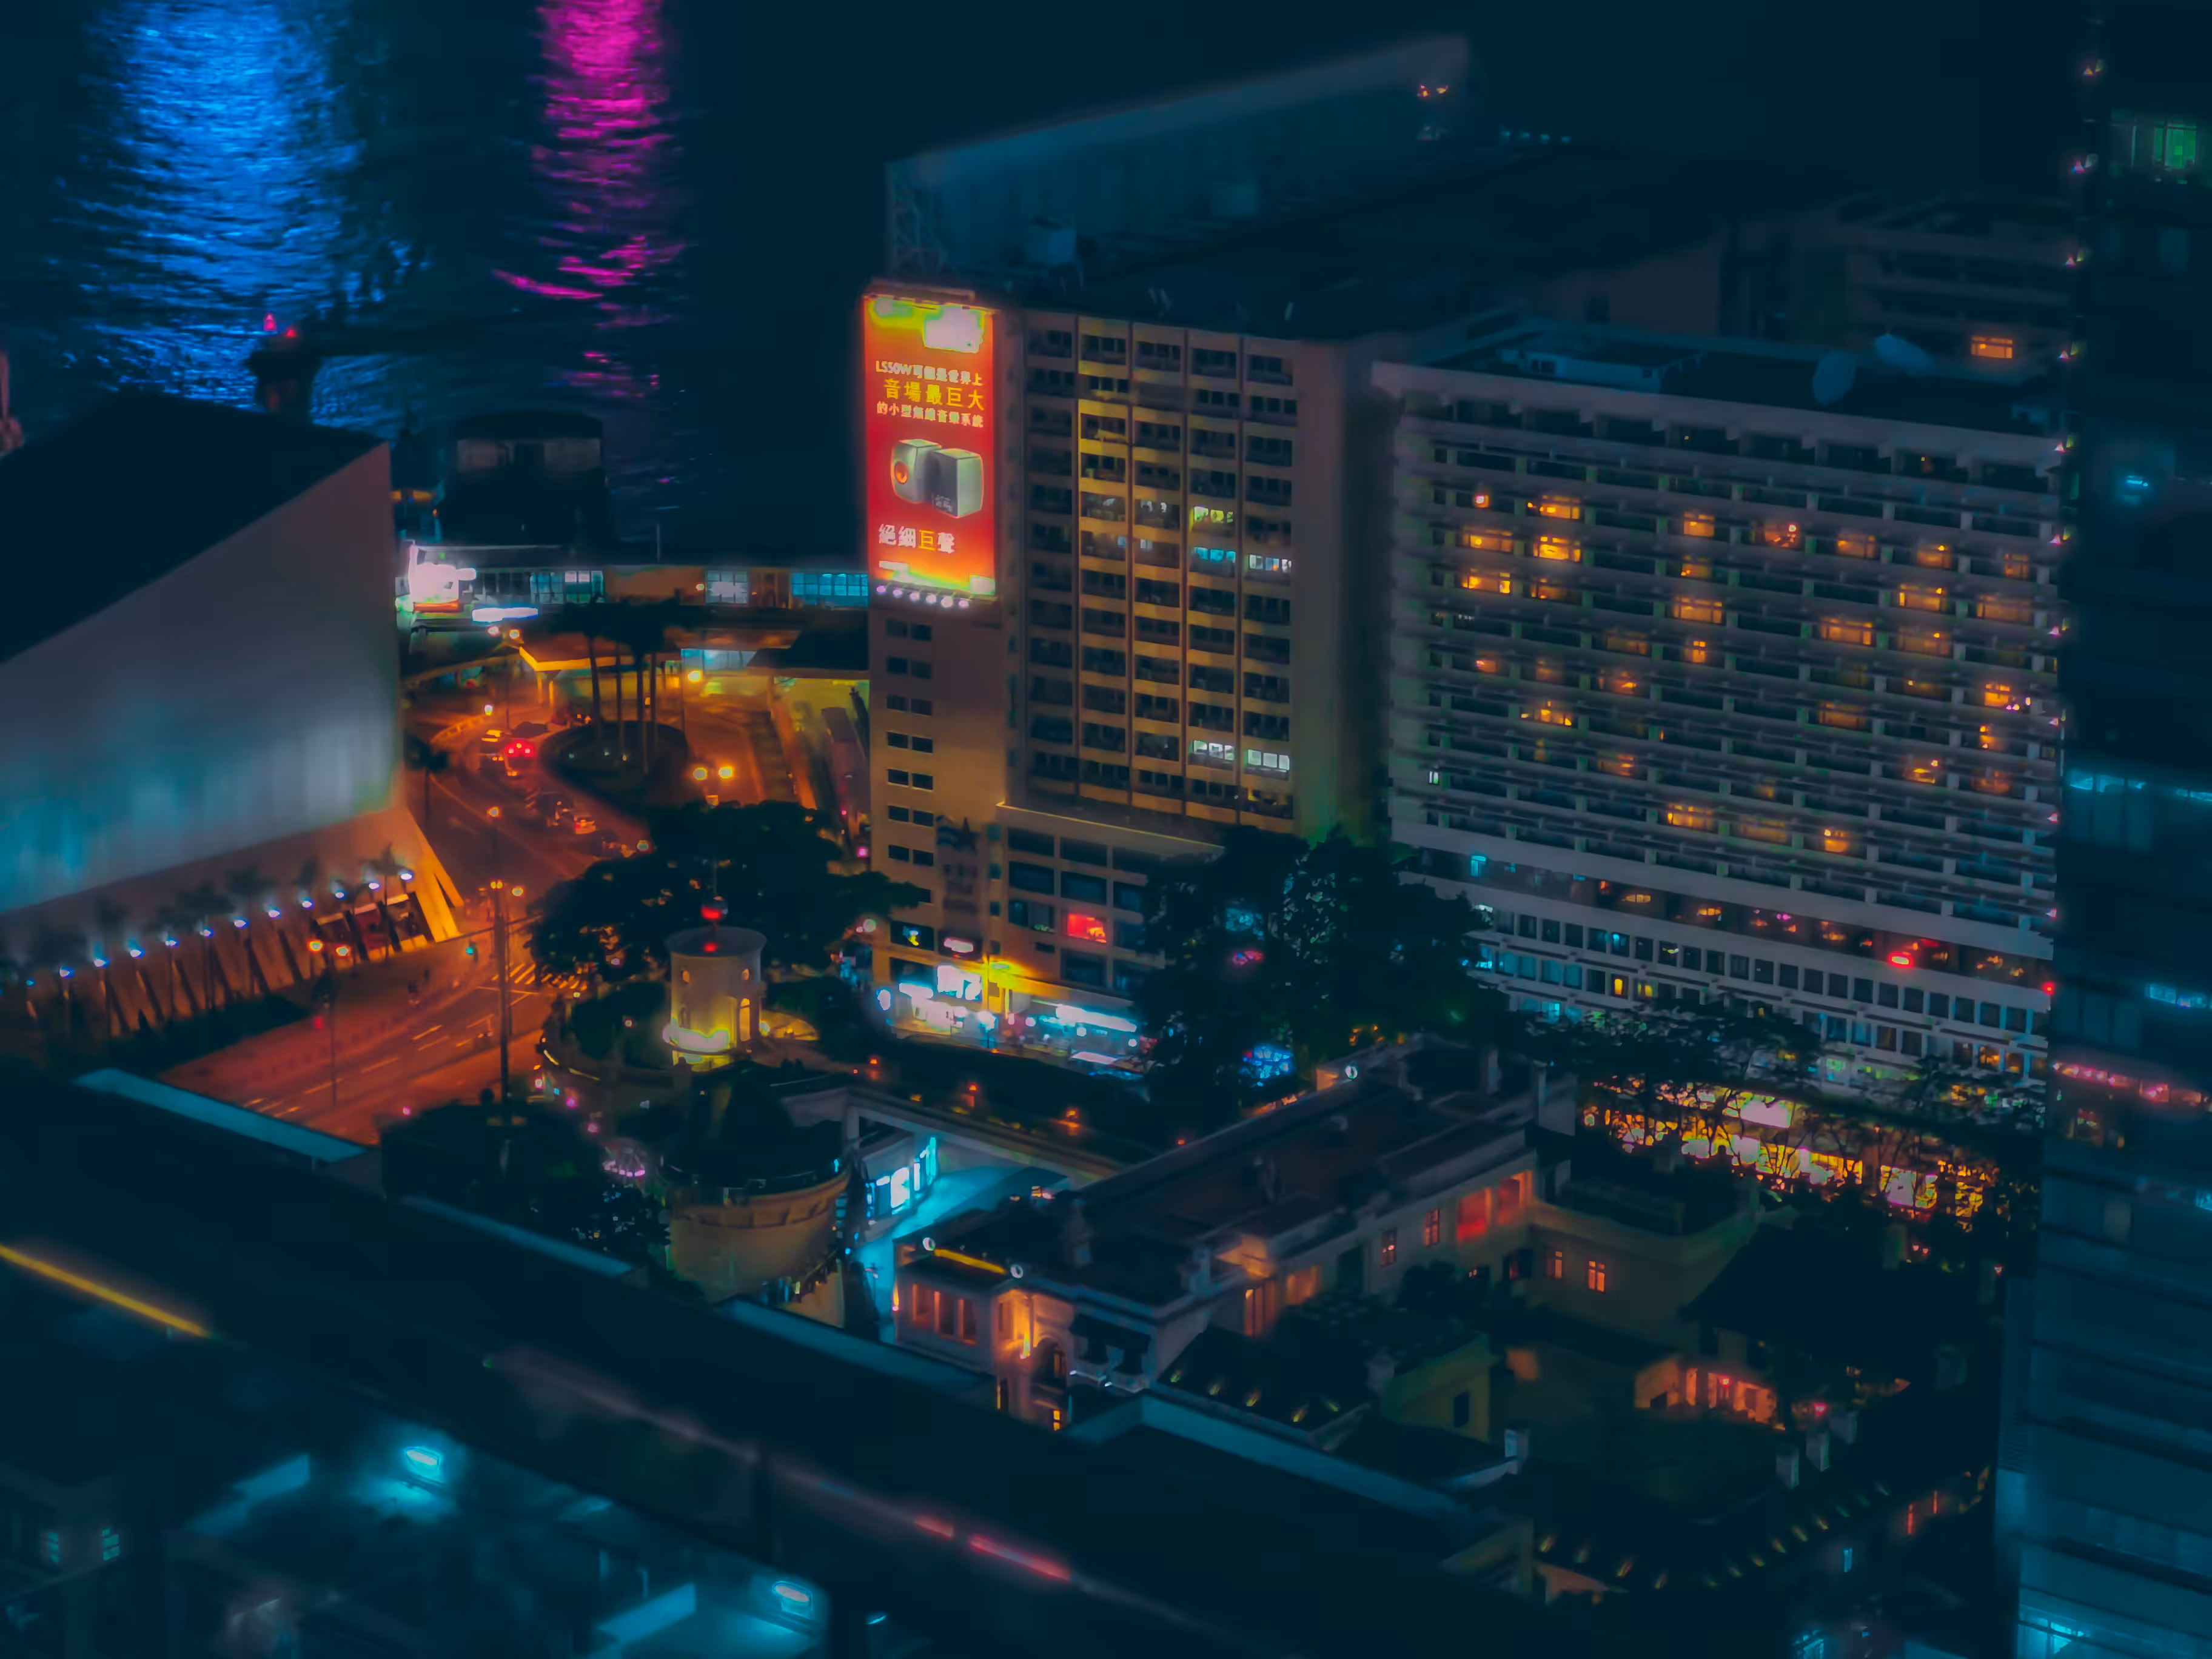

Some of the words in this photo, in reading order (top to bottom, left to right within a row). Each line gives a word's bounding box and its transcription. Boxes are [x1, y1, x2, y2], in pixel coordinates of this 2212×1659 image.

[883, 378, 984, 411] 音場最巨大
